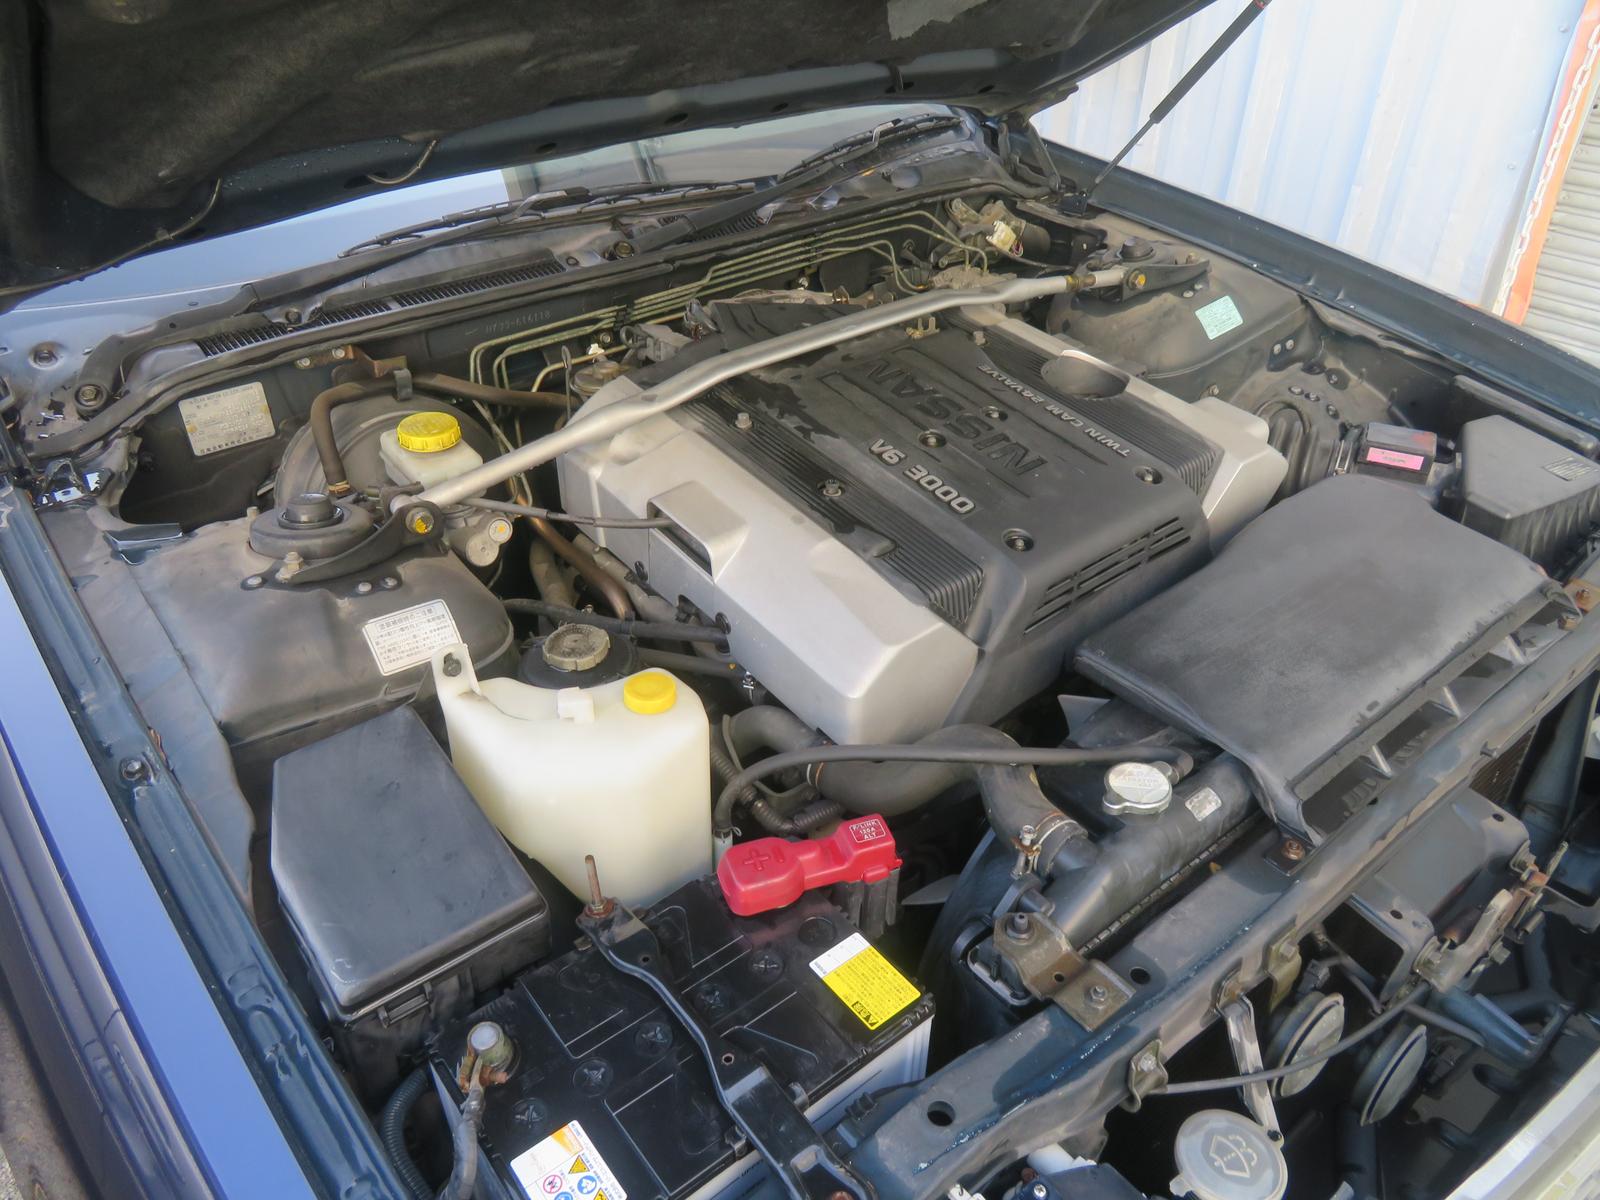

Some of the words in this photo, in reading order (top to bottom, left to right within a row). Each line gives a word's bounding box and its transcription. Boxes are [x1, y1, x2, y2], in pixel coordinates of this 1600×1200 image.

[978, 364, 1045, 404] 24VALVE
[866, 358, 1048, 476] NISSAN
[1045, 404, 1084, 427] CAM
[1085, 427, 1132, 457] TWIN
[869, 438, 906, 465] V6
[904, 464, 975, 514] 3000
